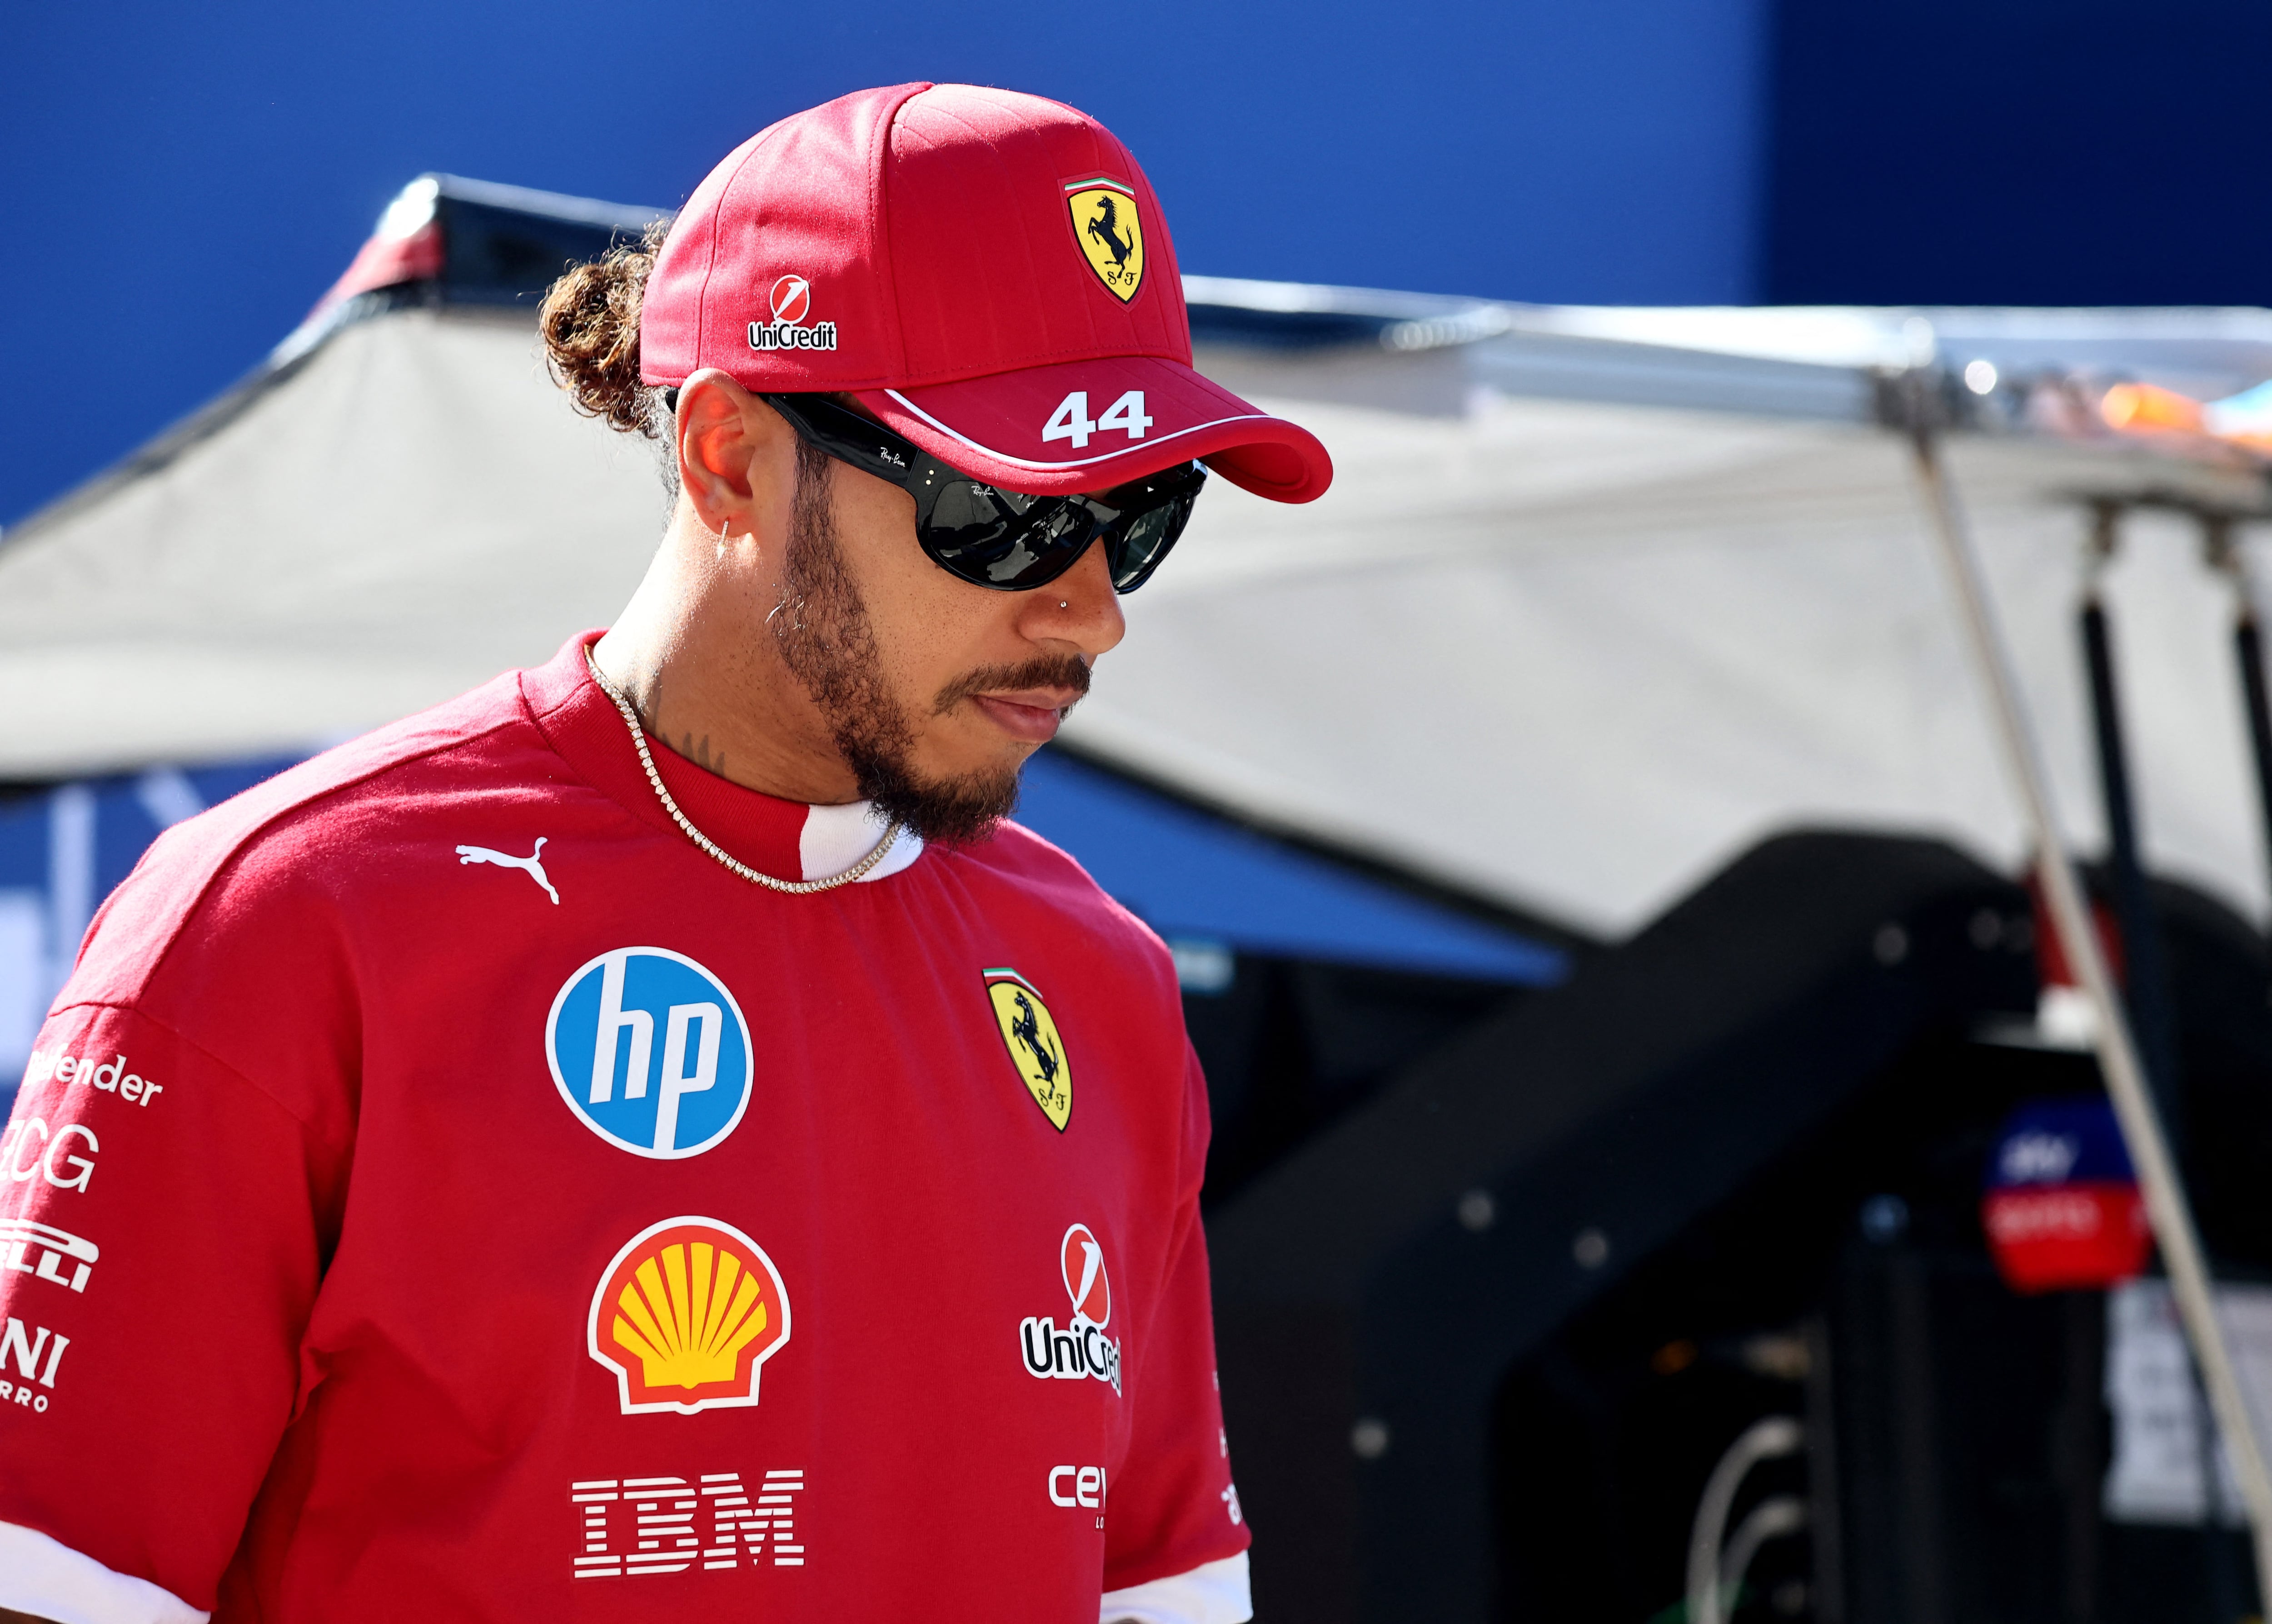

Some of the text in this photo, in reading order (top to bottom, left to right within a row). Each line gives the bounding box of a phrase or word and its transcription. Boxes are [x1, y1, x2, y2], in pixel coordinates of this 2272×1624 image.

[749, 323, 834, 348] UniCredit
[1042, 390, 1153, 448] 44
[881, 447, 905, 467] Ray-Ban
[589, 947, 723, 1152] hp
[1024, 1323, 1121, 1390] UniCred
[572, 1470, 804, 1578] IBM
